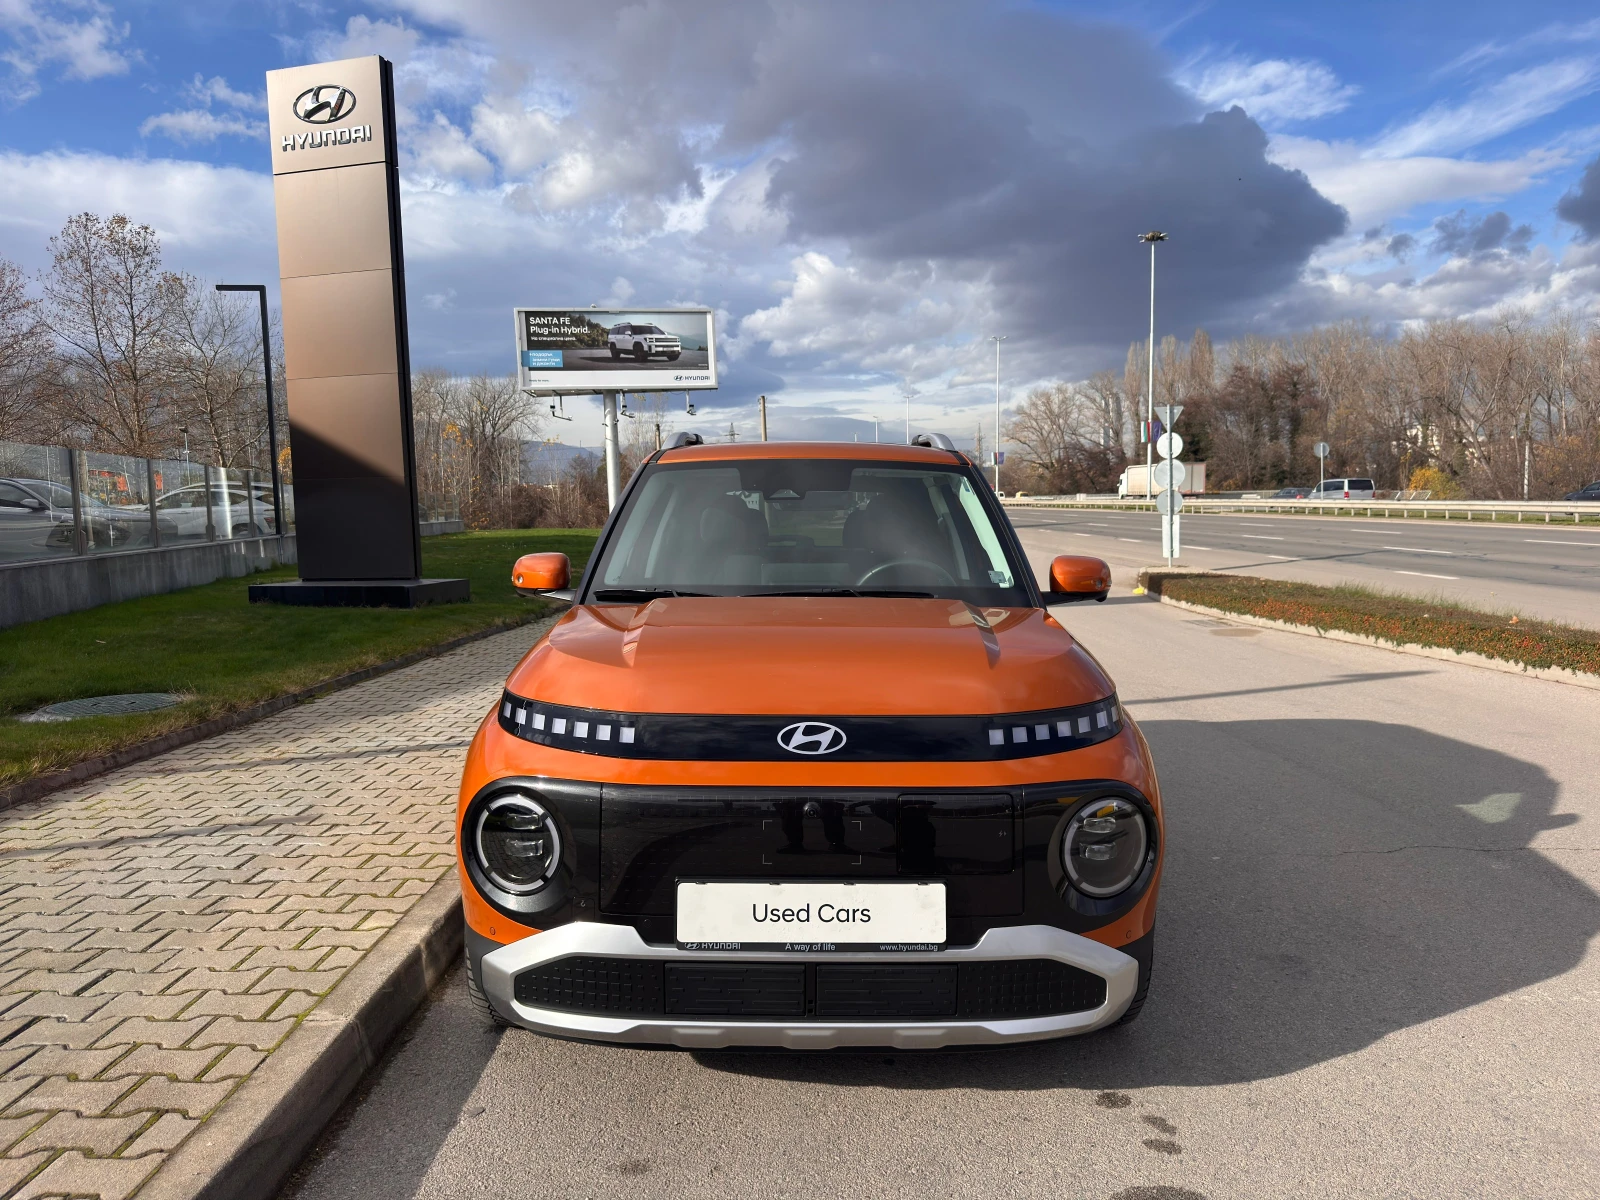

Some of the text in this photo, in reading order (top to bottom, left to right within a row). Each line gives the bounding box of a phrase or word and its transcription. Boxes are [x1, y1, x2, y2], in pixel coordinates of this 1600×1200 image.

[282, 124, 372, 152] HYUNDAI
[529, 317, 571, 325] SANTA FE
[530, 326, 591, 334] Plug-in Hybrid.
[752, 903, 872, 923] Used Cars
[785, 943, 836, 952] A way of life
[879, 943, 938, 952] www.hyundai.bg
